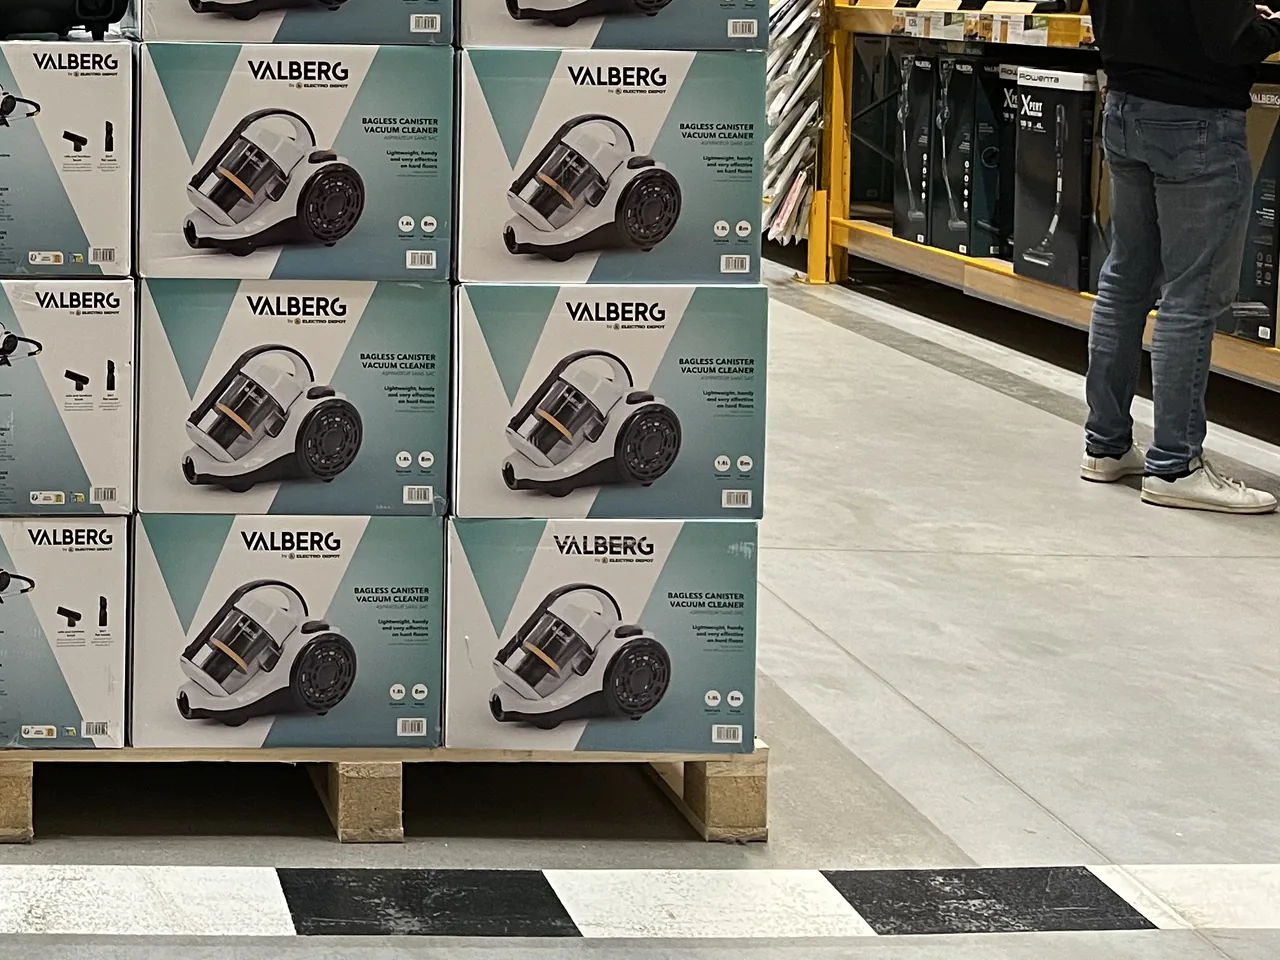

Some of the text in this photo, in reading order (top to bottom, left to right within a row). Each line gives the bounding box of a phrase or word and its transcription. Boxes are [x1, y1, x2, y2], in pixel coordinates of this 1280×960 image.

[33, 53, 118, 70] VALBERG
[247, 60, 349, 81] VALBERG
[567, 66, 667, 86] VALBERG
[362, 117, 439, 126] BAGLESS CANISTER
[364, 126, 439, 134] VACUUM CLEANER
[35, 292, 120, 308] VALBERG
[246, 296, 347, 316] VALBERG
[566, 302, 666, 321] VALBERG
[359, 353, 436, 361] BAGLESS CANISTER
[362, 362, 436, 370] VACUUM CLEANER
[28, 529, 113, 545] VALBERG
[241, 531, 341, 551] VALBERG
[553, 535, 654, 555] VALBERG
[354, 587, 430, 595] BAGLESS CANISTER
[355, 595, 392, 603] VACUUM
